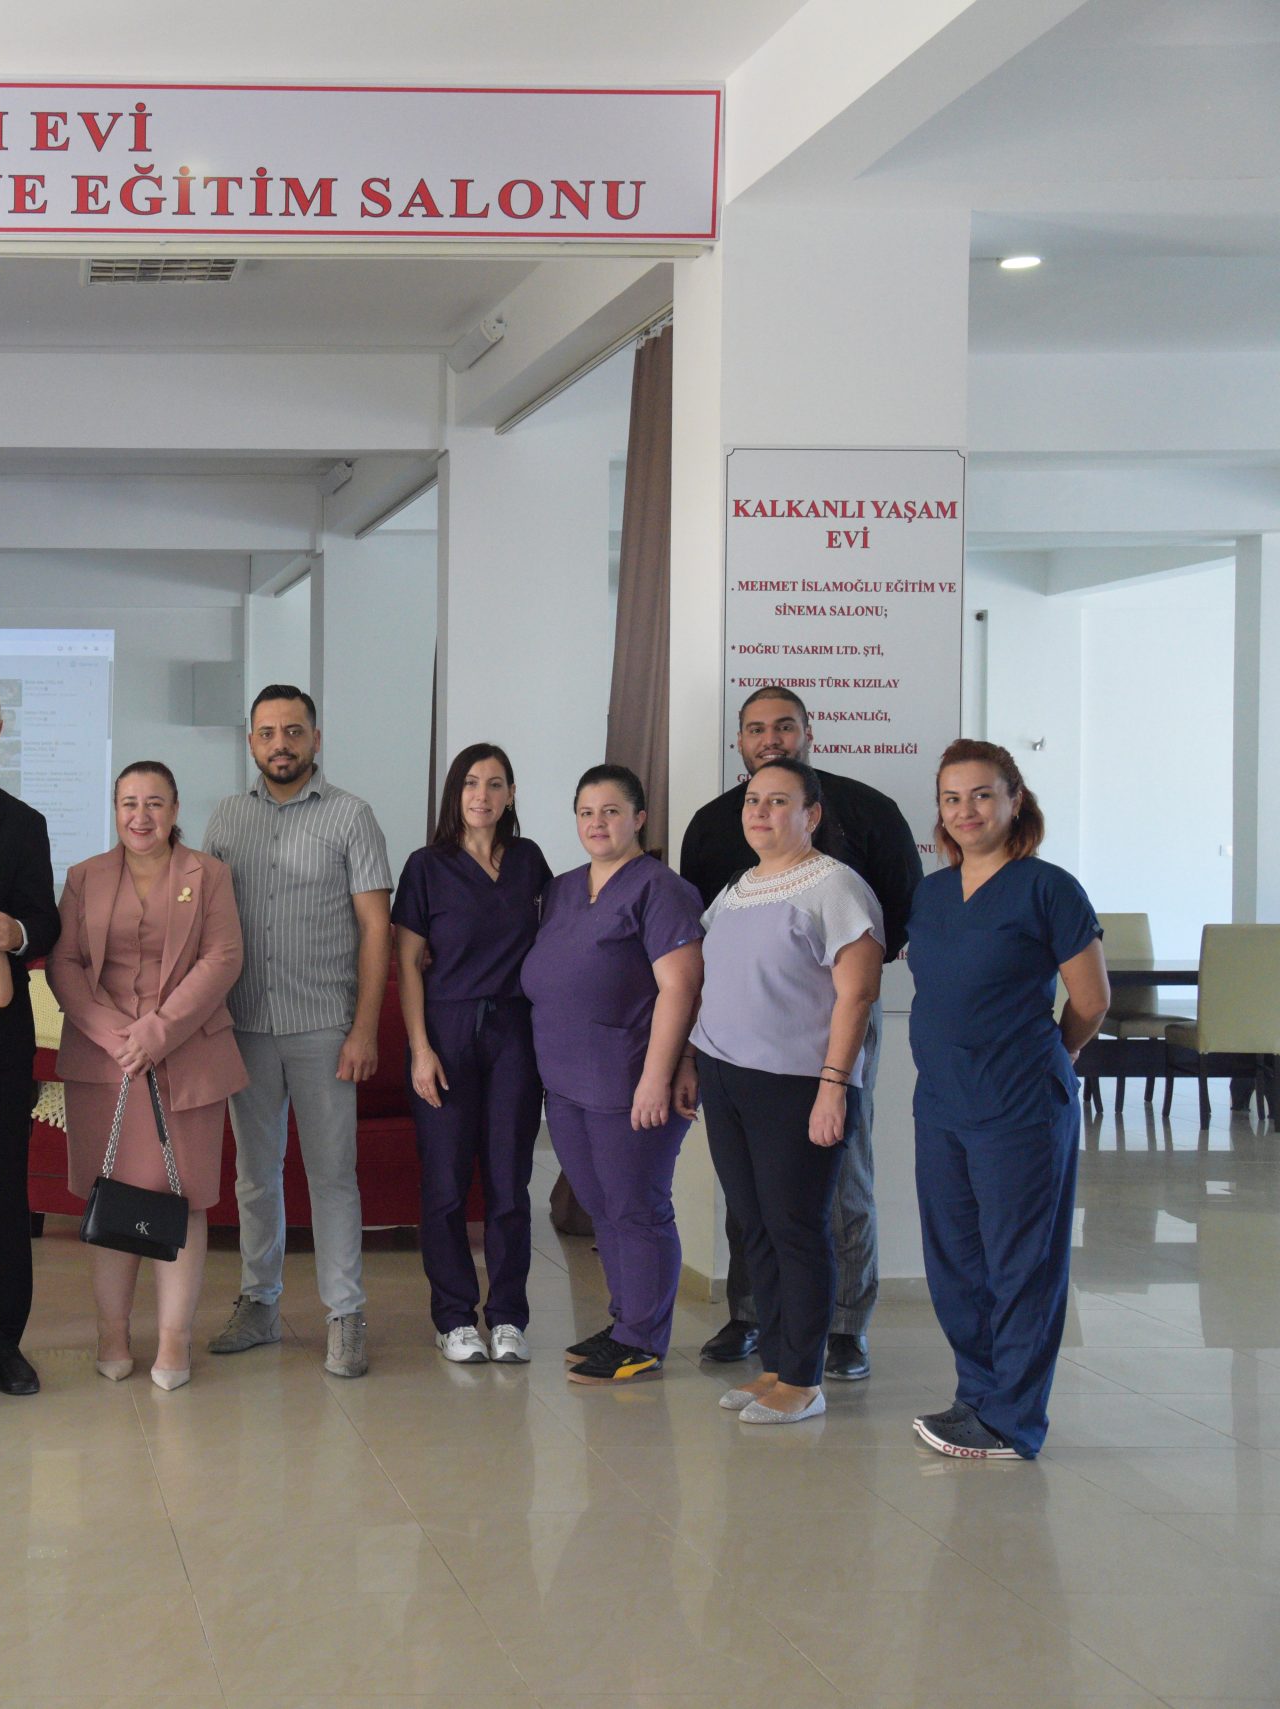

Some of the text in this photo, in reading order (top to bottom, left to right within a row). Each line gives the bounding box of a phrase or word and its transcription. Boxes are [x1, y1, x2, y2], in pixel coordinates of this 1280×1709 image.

[30, 102, 153, 152] EVİ
[70, 163, 339, 217] EĞİTİM
[360, 177, 647, 221] SALONU
[732, 499, 958, 523] KALKANLI YAŞAM
[825, 526, 871, 549] EVİ
[737, 579, 957, 593] MEHMET İSLAMOĞLU EĞİTİM VE
[774, 603, 888, 618] SİNEMA SALONU;
[738, 642, 884, 657] DOĞRU TASARIM LTD. ŞTİ,
[819, 676, 850, 688] TÜRK
[853, 678, 900, 689] KIZILAY
[818, 709, 891, 723] BAŞKANLIĞI,
[874, 742, 918, 755] BİRLİĞİ
[942, 1443, 988, 1459] crocs
